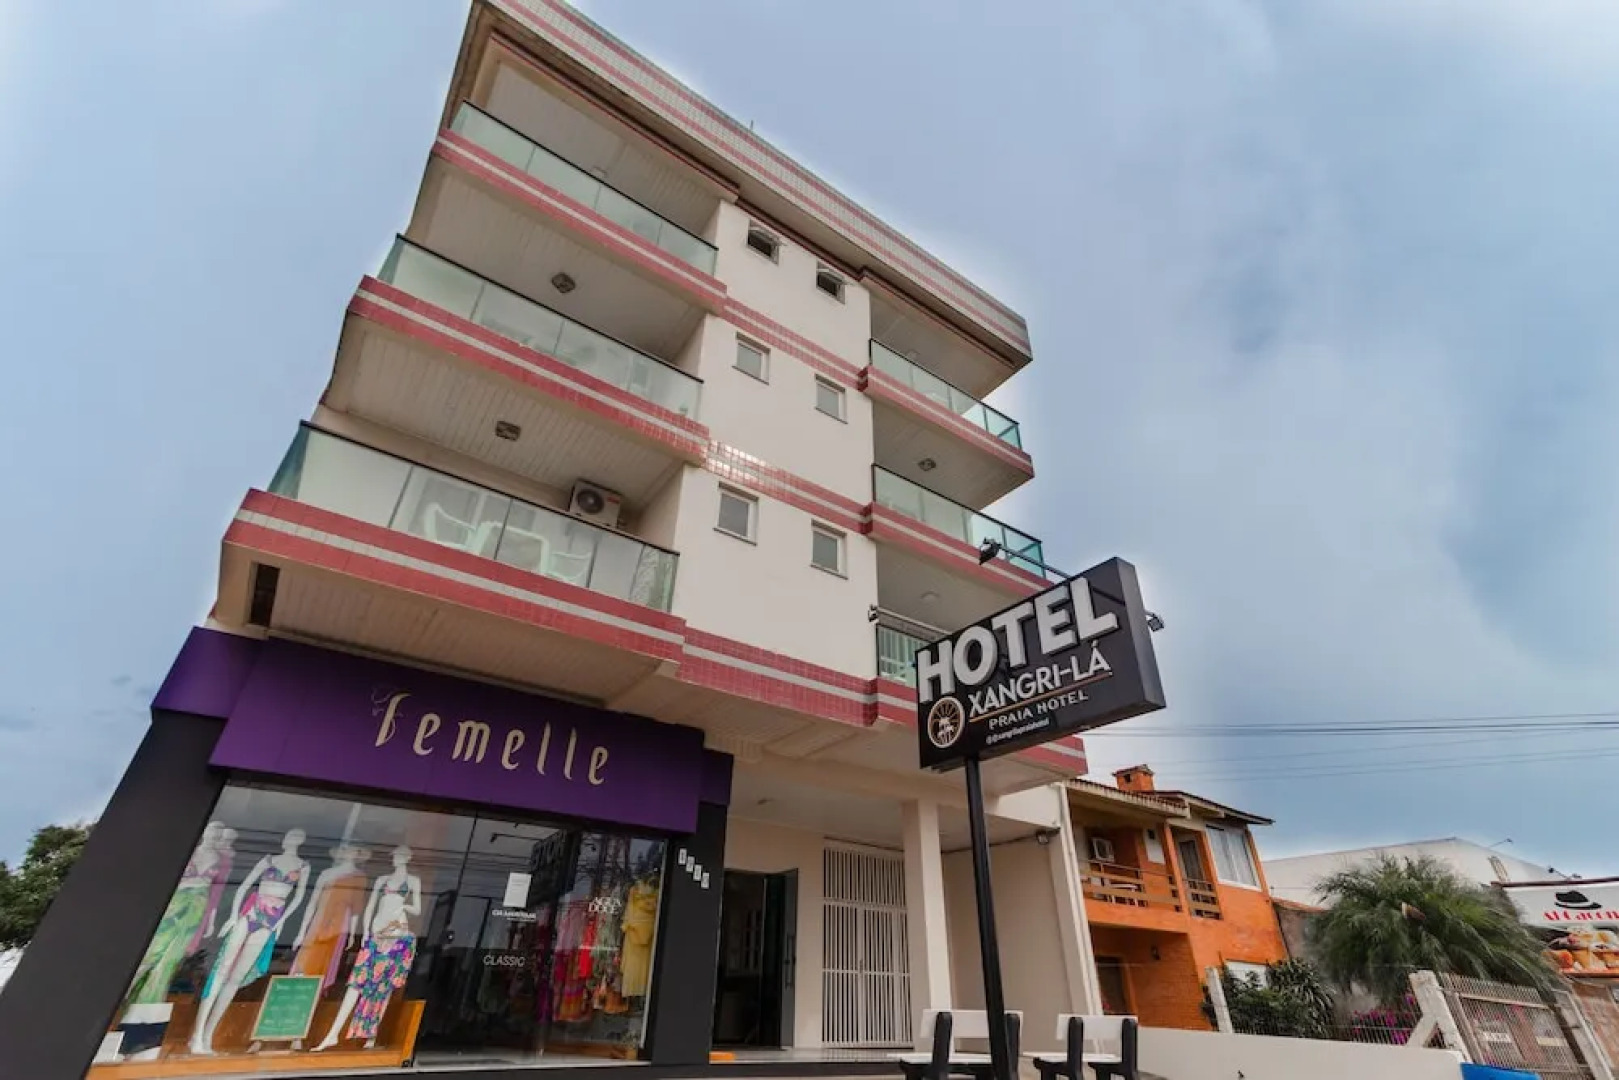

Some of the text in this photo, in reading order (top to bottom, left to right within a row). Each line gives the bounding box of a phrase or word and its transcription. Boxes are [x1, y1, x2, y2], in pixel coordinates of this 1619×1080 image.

[917, 577, 1119, 704] HOTEL
[968, 639, 1111, 717] XANGRI-LÁ
[371, 690, 609, 785] Femelle
[988, 689, 1089, 730] PRAIA HOTEL
[483, 954, 526, 968] CLASSIC
